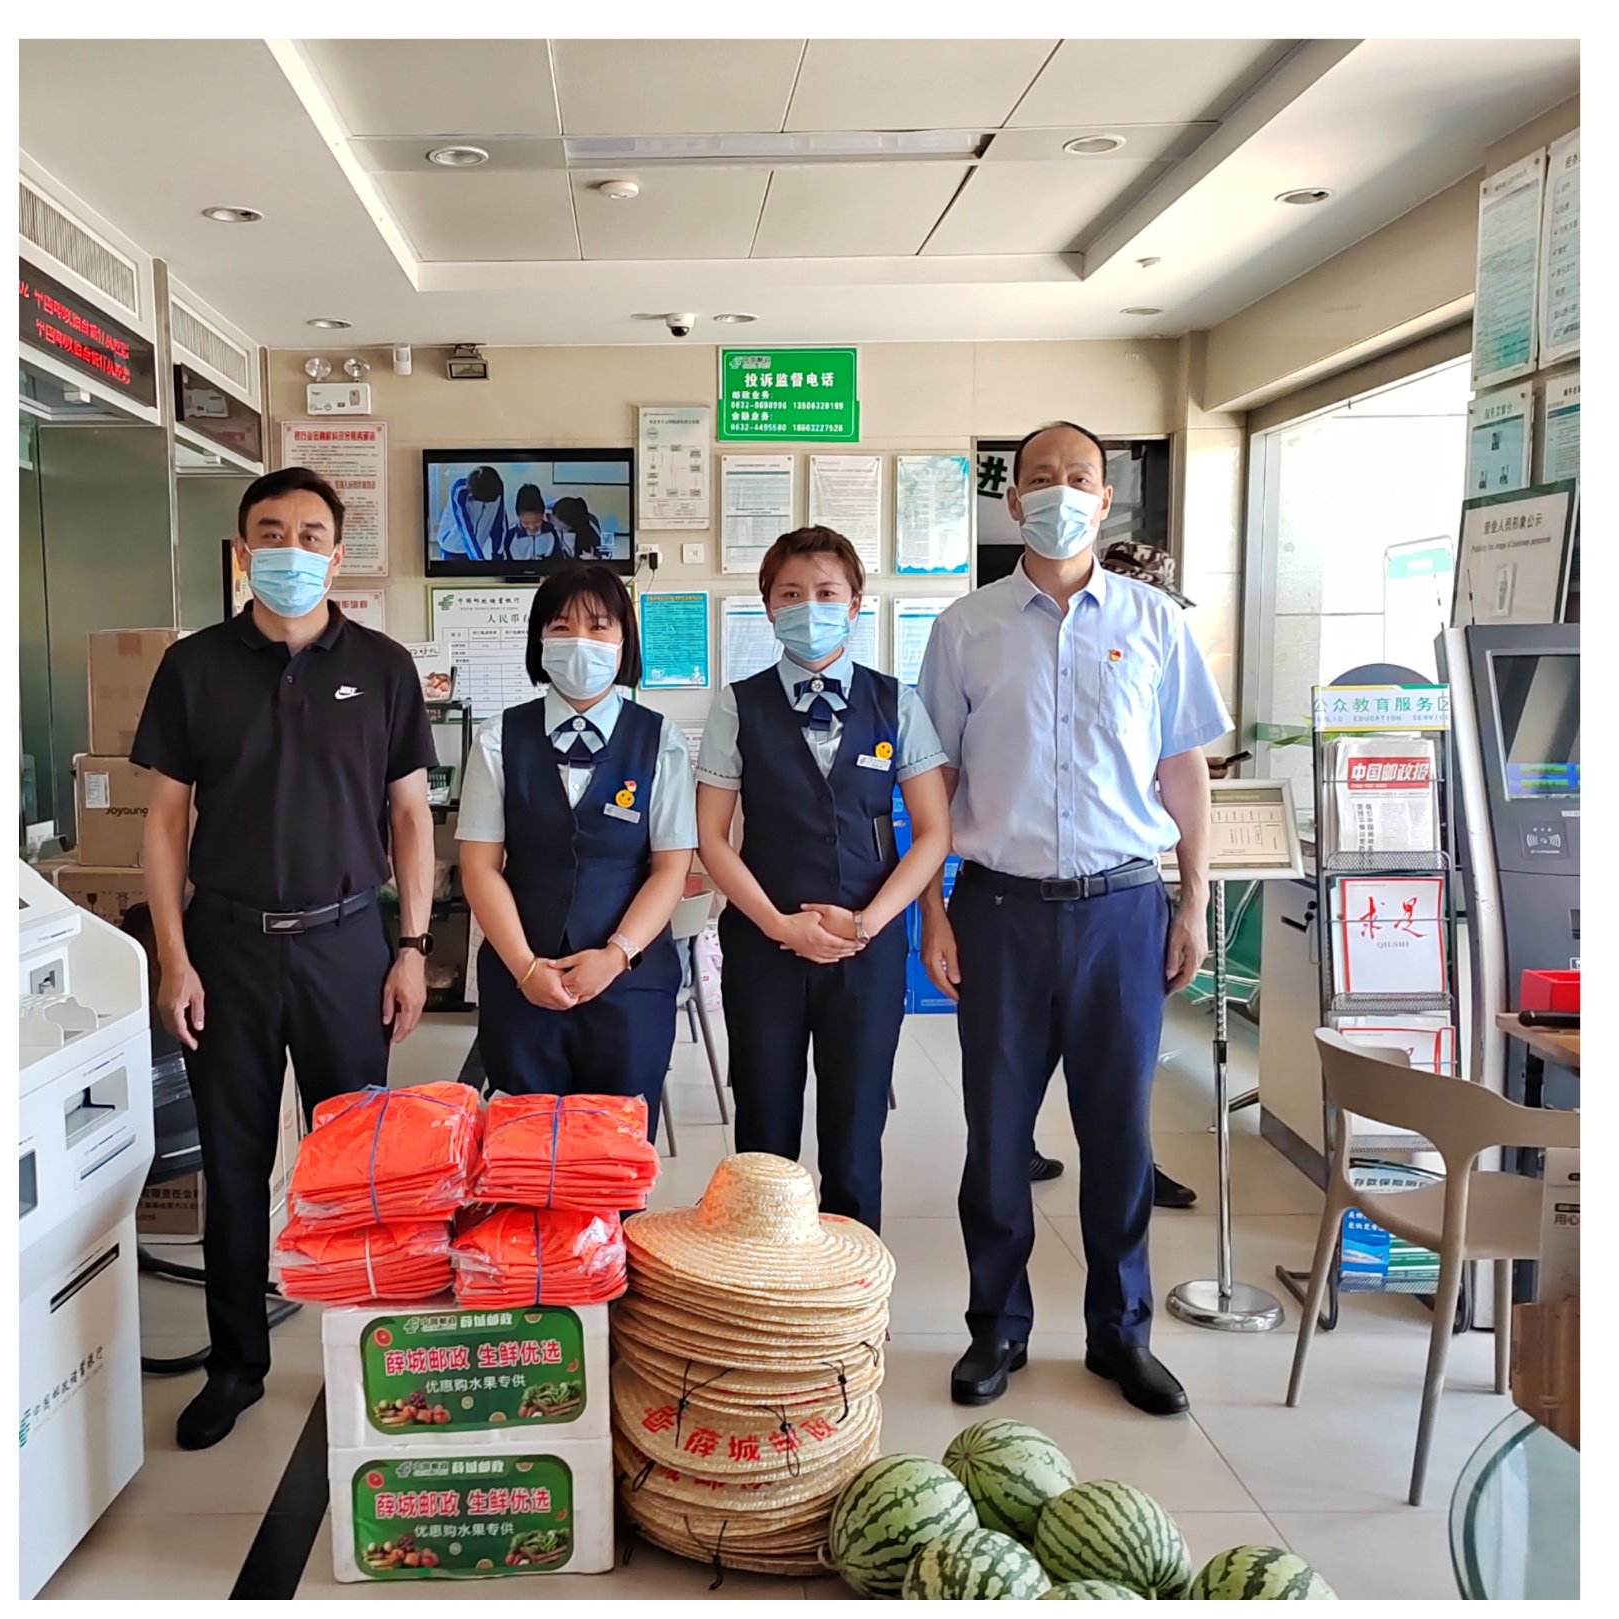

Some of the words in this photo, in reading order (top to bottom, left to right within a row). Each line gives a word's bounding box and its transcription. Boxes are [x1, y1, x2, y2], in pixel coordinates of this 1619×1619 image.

[744, 372, 834, 387] 投诉监督电话
[977, 454, 1009, 500] 进
[1483, 512, 1543, 535] 营业人员形象公示
[340, 685, 358, 695] NIKE
[1351, 762, 1430, 782] 中国邮政报
[105, 807, 148, 817] Joyoung
[1359, 896, 1428, 940] 求是
[1377, 941, 1409, 949] QIUSHI
[384, 1344, 470, 1377] 薛城邮政
[477, 1338, 562, 1368] 生鲜优选
[425, 1374, 527, 1394] 优惠购水果专供
[375, 1489, 460, 1520] 薛城邮政
[467, 1486, 551, 1516] 生鲜优选
[414, 1521, 515, 1539] 优惠购水果专供
